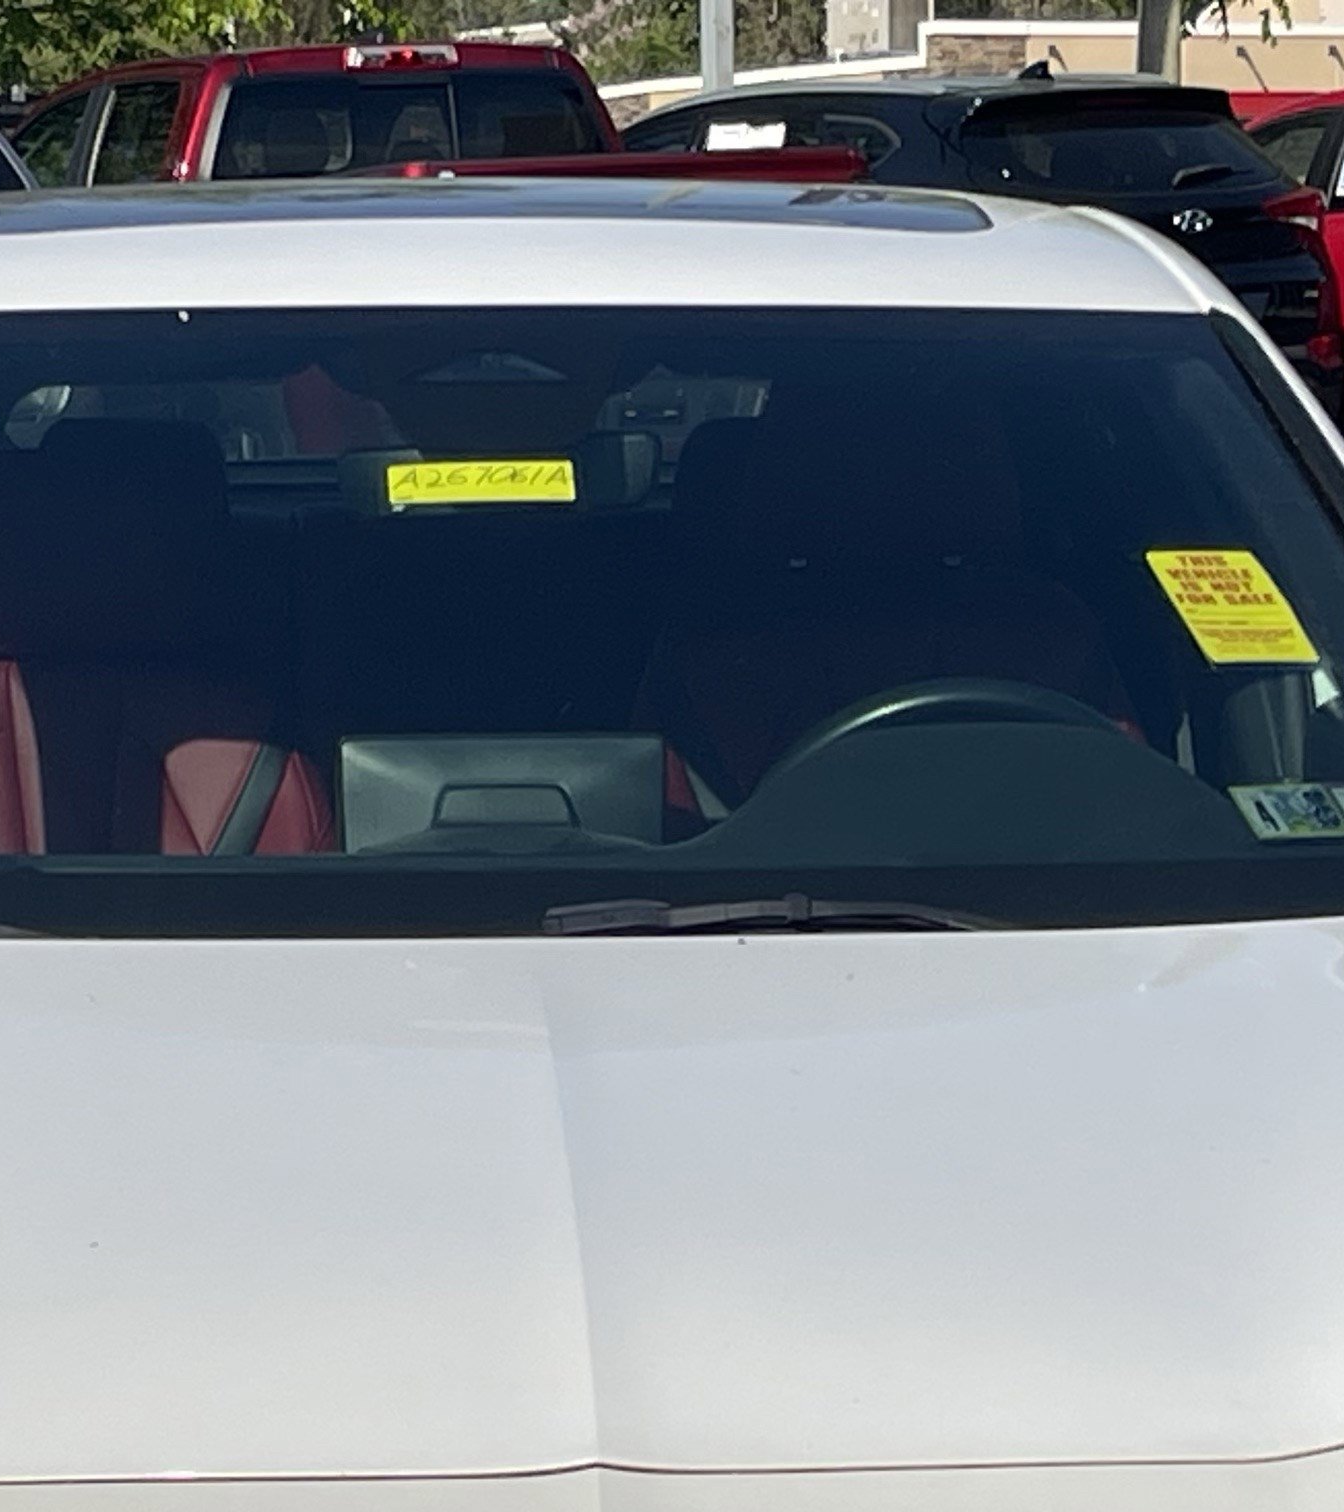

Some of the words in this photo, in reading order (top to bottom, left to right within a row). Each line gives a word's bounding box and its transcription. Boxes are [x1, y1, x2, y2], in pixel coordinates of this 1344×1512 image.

[1176, 556, 1228, 567] THIS
[1165, 568, 1253, 581] VEHICLE
[1209, 581, 1253, 593] NOT
[1174, 593, 1218, 606] FOR
[1222, 593, 1277, 605] SALE
